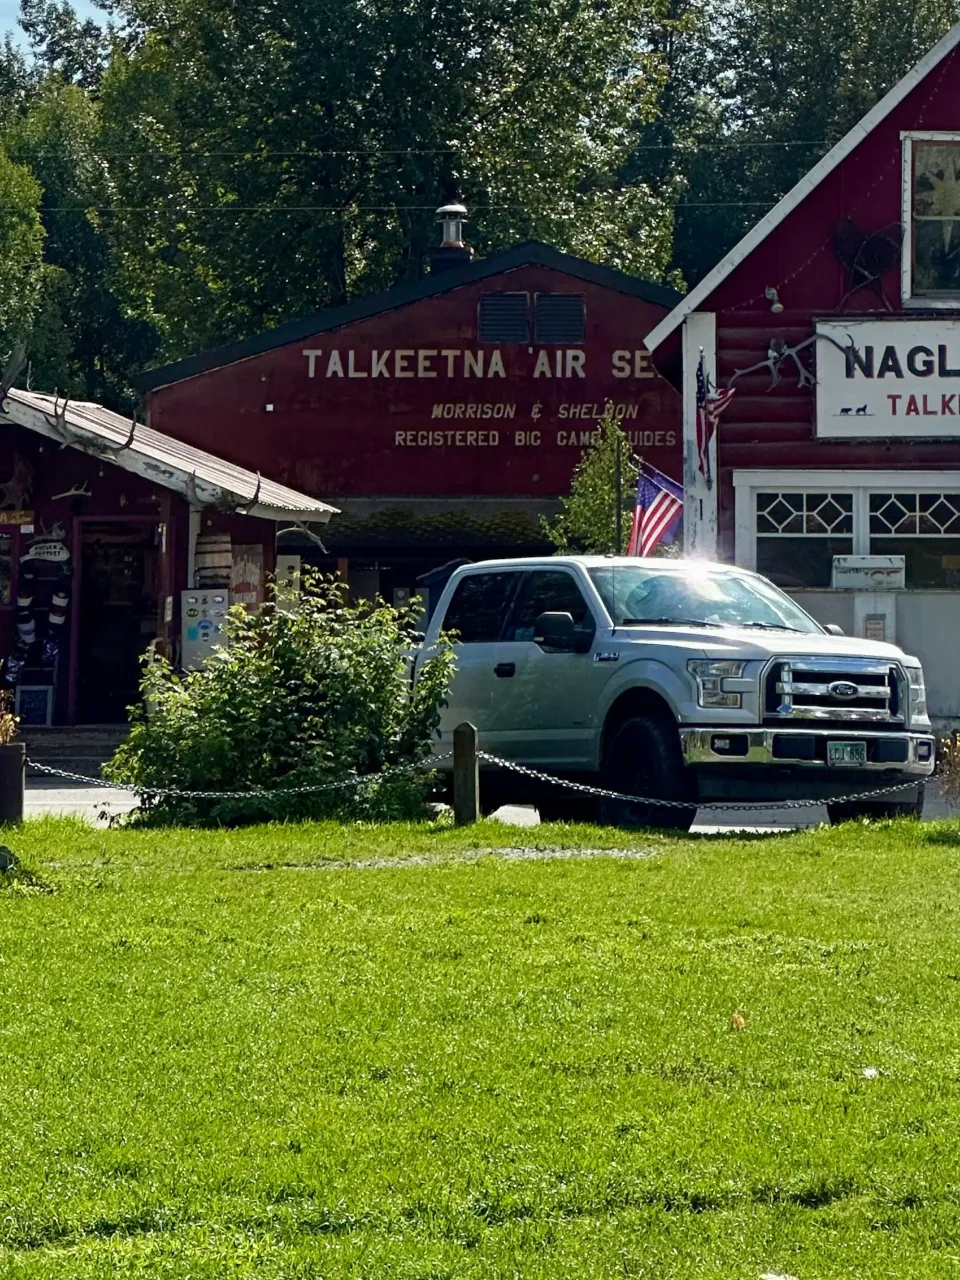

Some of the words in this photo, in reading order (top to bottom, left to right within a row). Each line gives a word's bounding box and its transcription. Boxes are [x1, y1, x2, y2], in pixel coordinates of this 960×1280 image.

[302, 349, 506, 378] TALKEETNA
[533, 349, 586, 378] AIR
[611, 349, 662, 378] SE
[431, 403, 516, 419] MORRISON
[531, 404, 543, 422] &
[395, 431, 500, 447] REGISTERED
[514, 431, 541, 446] BIG
[625, 431, 677, 447] UIDES
